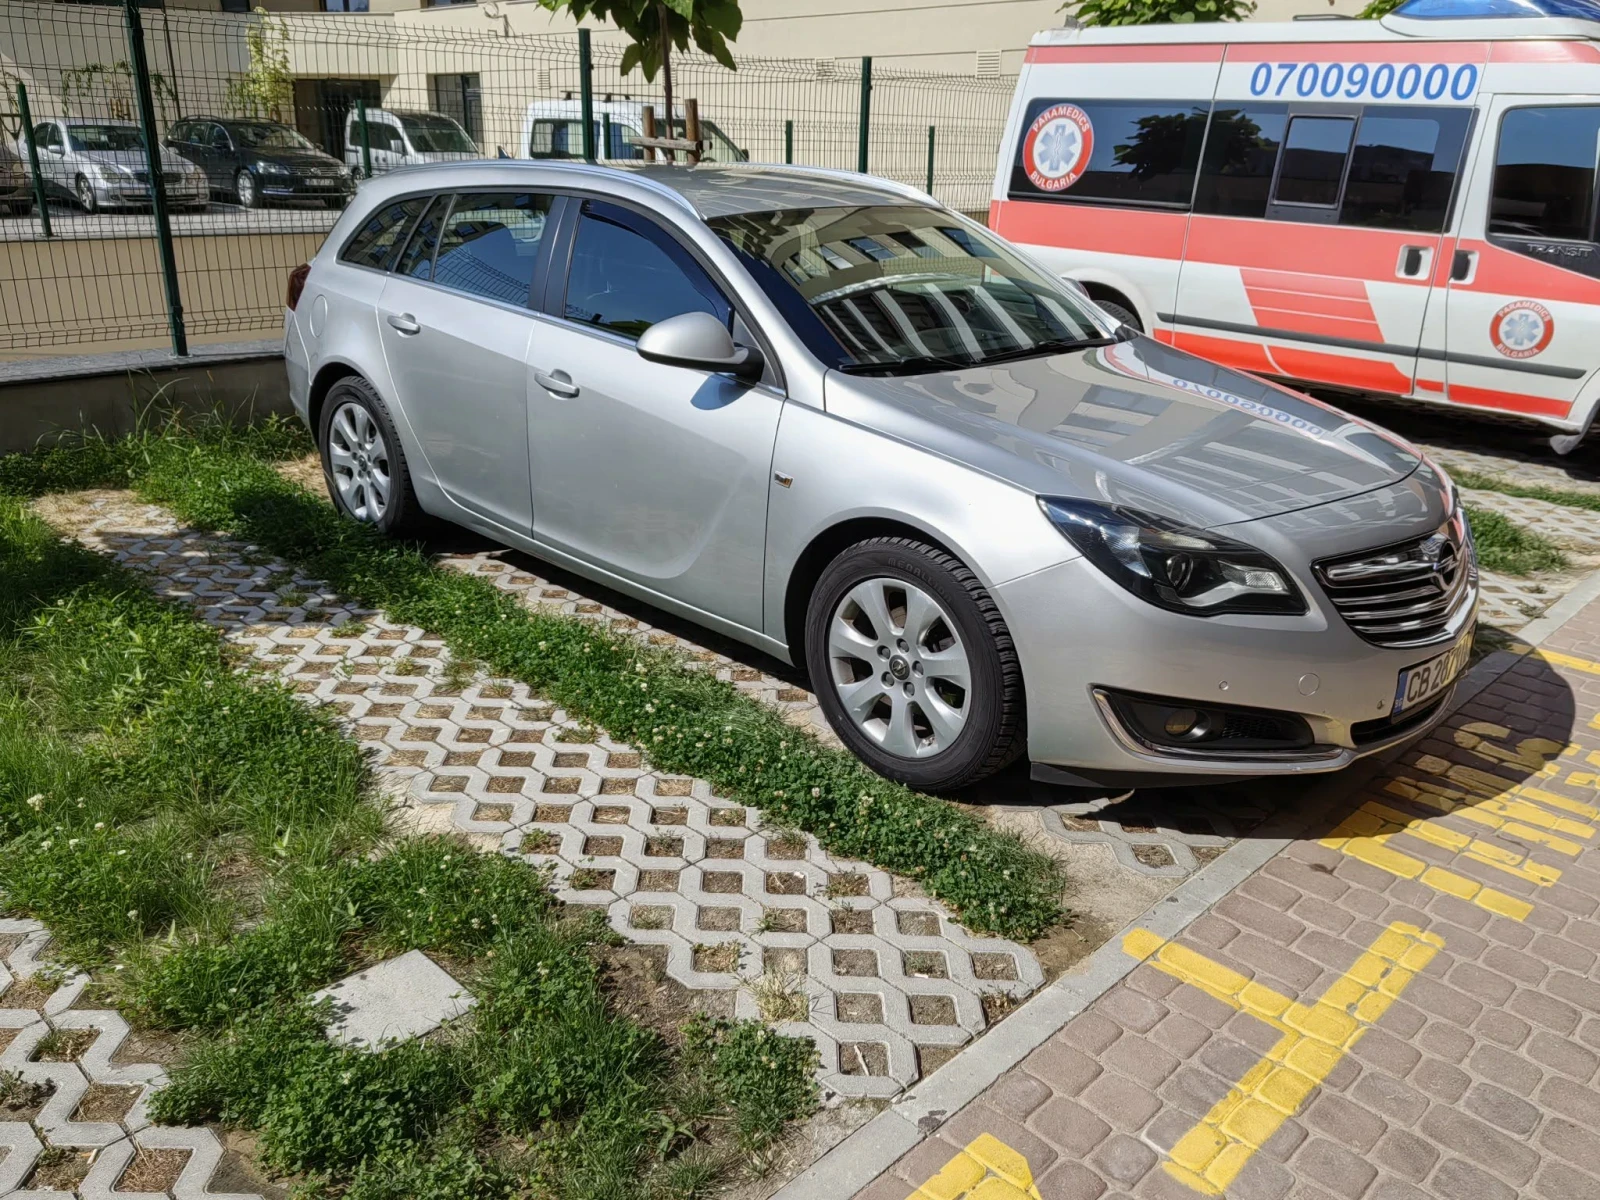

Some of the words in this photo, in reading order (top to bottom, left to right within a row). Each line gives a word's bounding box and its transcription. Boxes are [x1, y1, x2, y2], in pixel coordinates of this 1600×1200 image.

[1250, 62, 1478, 101] 070090000
[1032, 106, 1090, 132] PARAMEDICS
[1030, 170, 1077, 190] BULGARIA
[1527, 243, 1594, 257] TRANSIT
[1498, 301, 1551, 321] PARAMEDICS
[1496, 343, 1541, 359] BULGARIA
